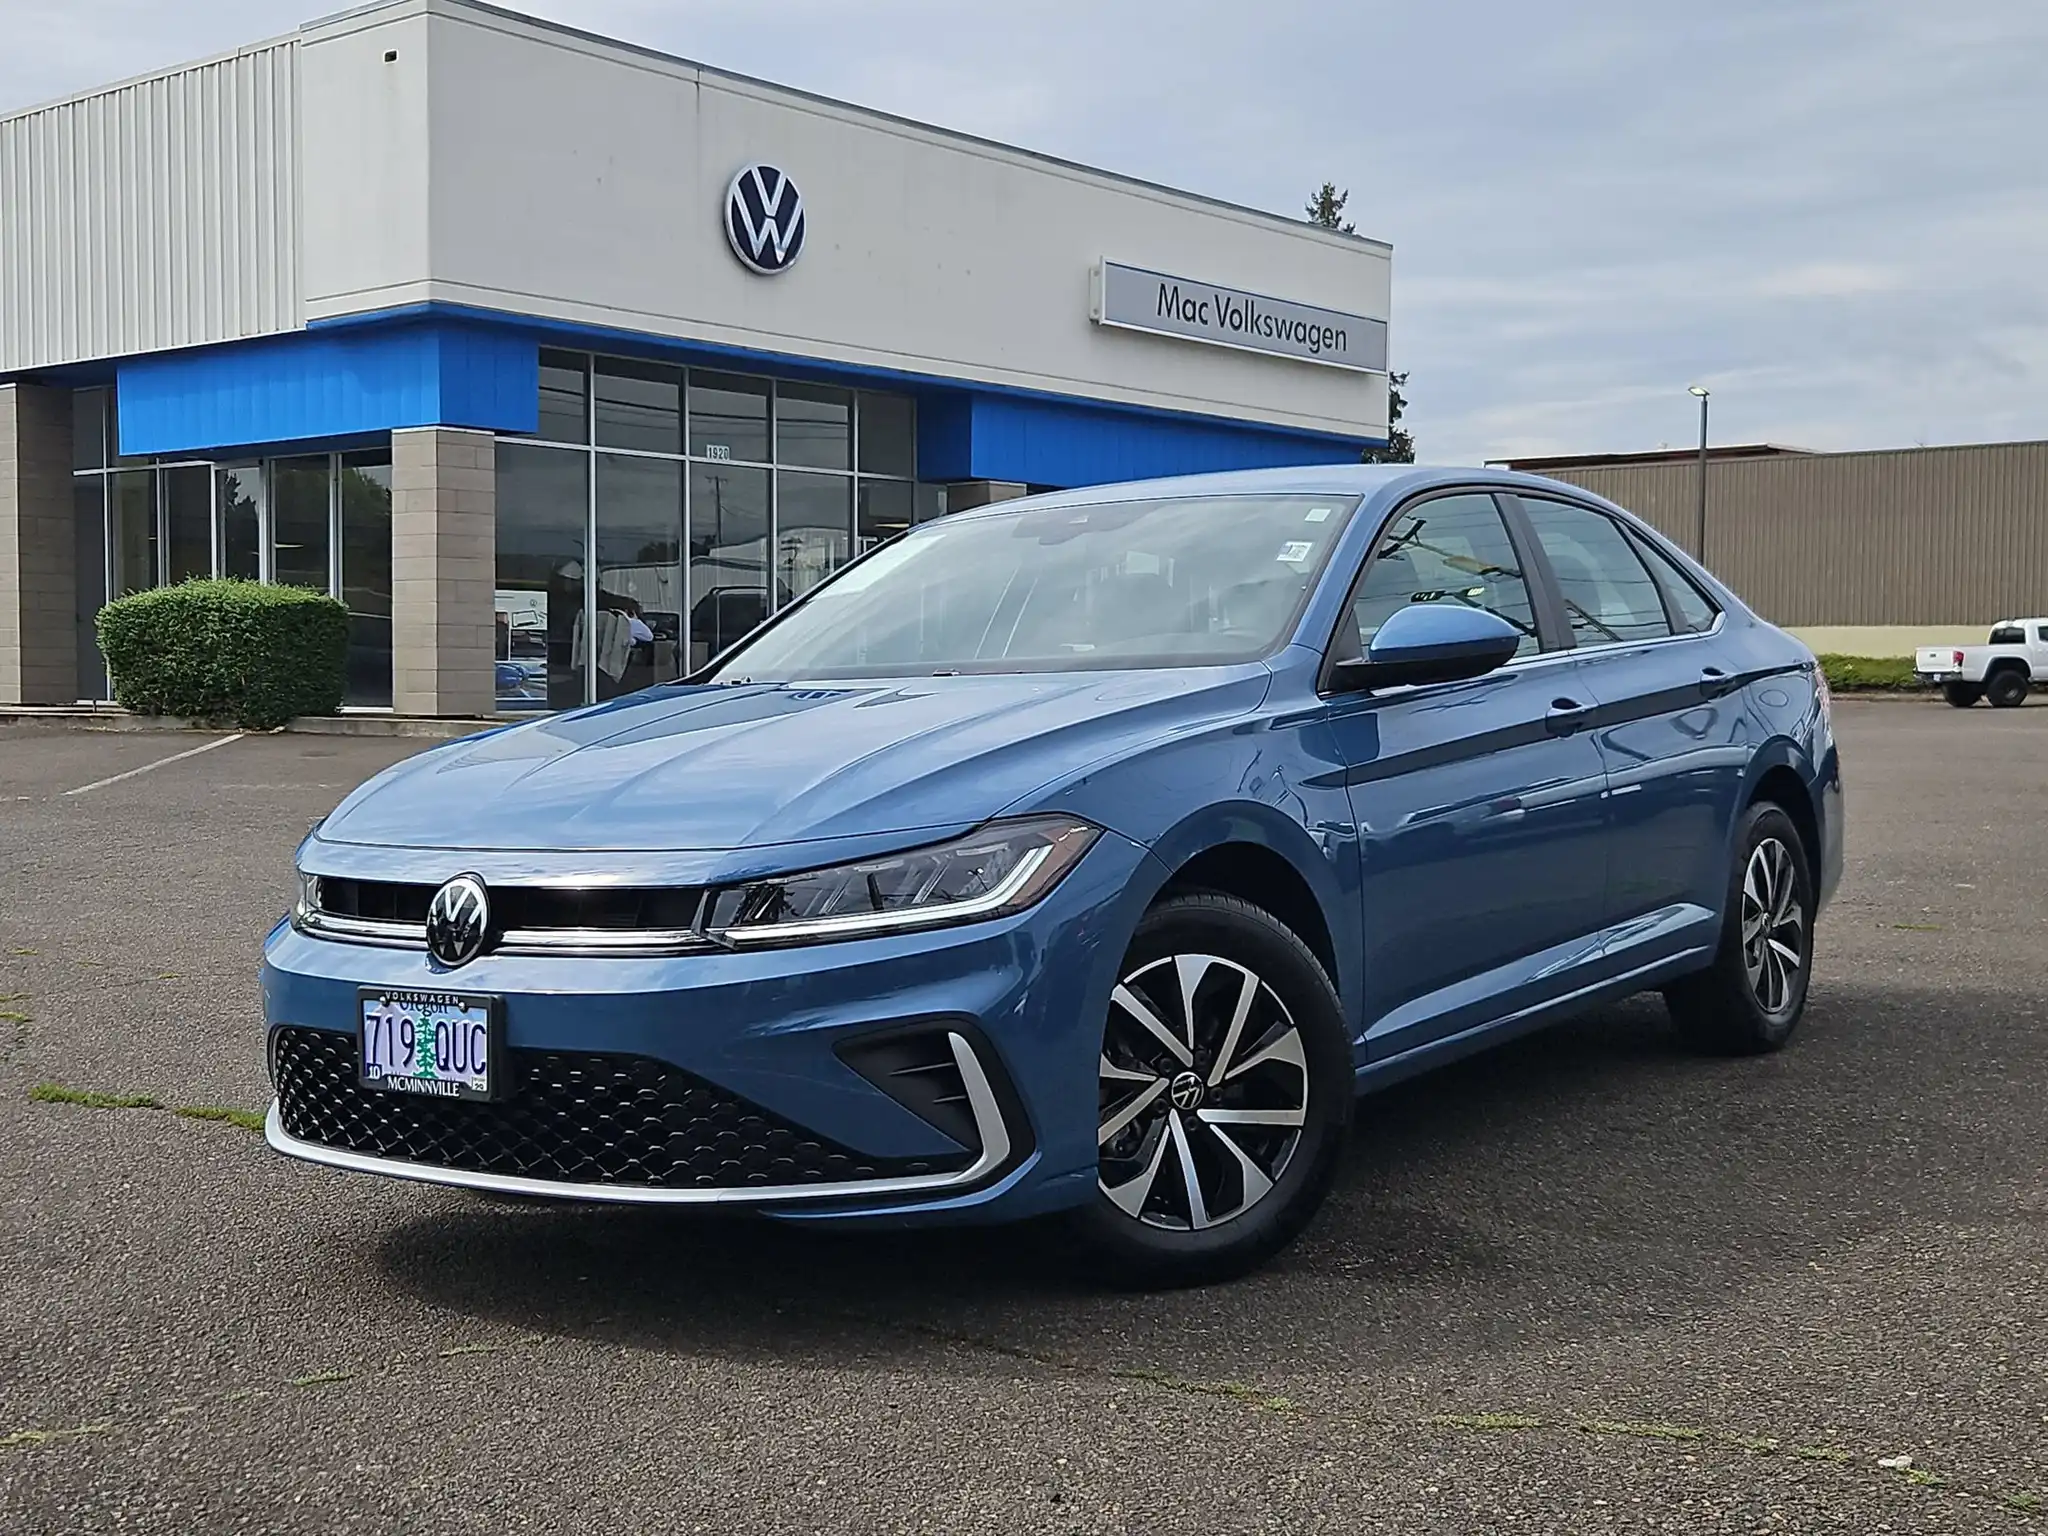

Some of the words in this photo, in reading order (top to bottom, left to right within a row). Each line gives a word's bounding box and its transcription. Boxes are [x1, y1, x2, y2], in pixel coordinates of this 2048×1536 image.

[1156, 283, 1209, 326] Mac
[1214, 294, 1347, 354] Volkswagen
[708, 446, 729, 460] 1920
[385, 991, 459, 1004] VOLKSWAGEN
[366, 1014, 415, 1068] 719
[435, 1021, 487, 1075] QUC
[368, 1065, 380, 1079] 10
[386, 1075, 460, 1097] MCMINNVILLE
